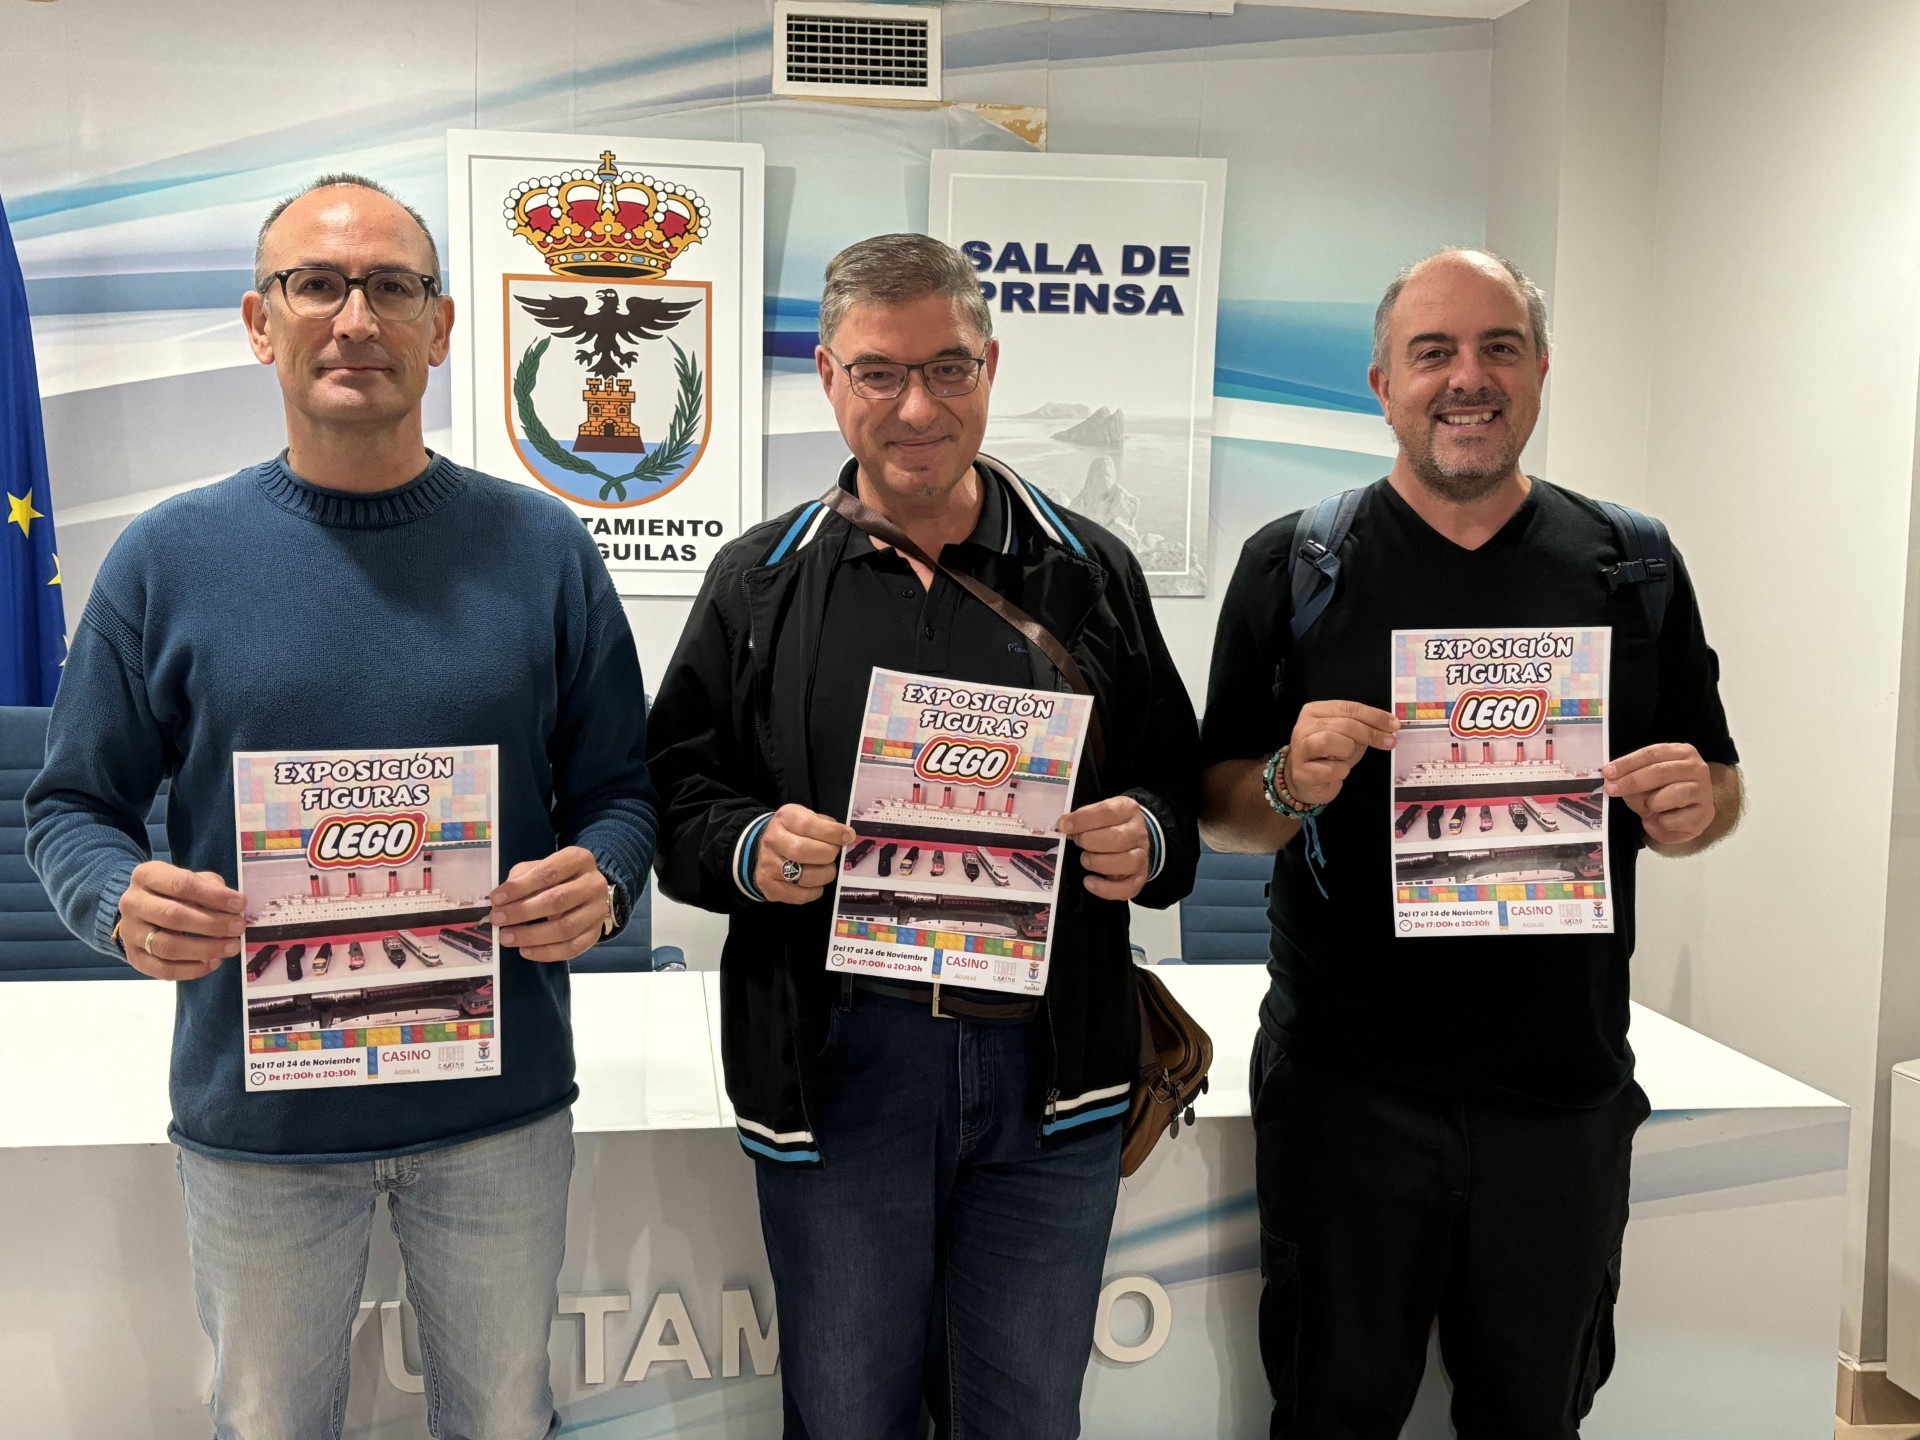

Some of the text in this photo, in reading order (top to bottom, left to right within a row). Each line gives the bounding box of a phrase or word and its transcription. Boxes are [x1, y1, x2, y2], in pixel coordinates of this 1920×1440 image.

[960, 240, 1191, 277] SALA DE
[579, 517, 724, 538] TAMIENTO
[597, 543, 697, 562] GUILAS
[1424, 632, 1574, 660] EXPOSICIÓN
[1446, 662, 1552, 685] FIGURAS
[902, 683, 1055, 719] EXPOSICIÓN
[1458, 696, 1540, 730] LEGO
[919, 708, 1028, 739] FIGURAS
[275, 752, 454, 784] EXPOSICIÓN
[924, 742, 1009, 780] LEGO
[301, 784, 430, 811] FIGURAS
[318, 821, 416, 860] LEGO
[1398, 910, 1411, 918] Del
[1440, 909, 1450, 917] de
[1451, 908, 1493, 917] Noviembre
[1511, 905, 1553, 916] CASINO
[832, 944, 846, 952] Del
[875, 949, 885, 957] de
[886, 951, 928, 962] Noviembre
[945, 956, 989, 970] CASINO
[250, 1056, 361, 1070] Del 17 al 24 de Noviembre
[382, 1049, 431, 1063] CASINO
